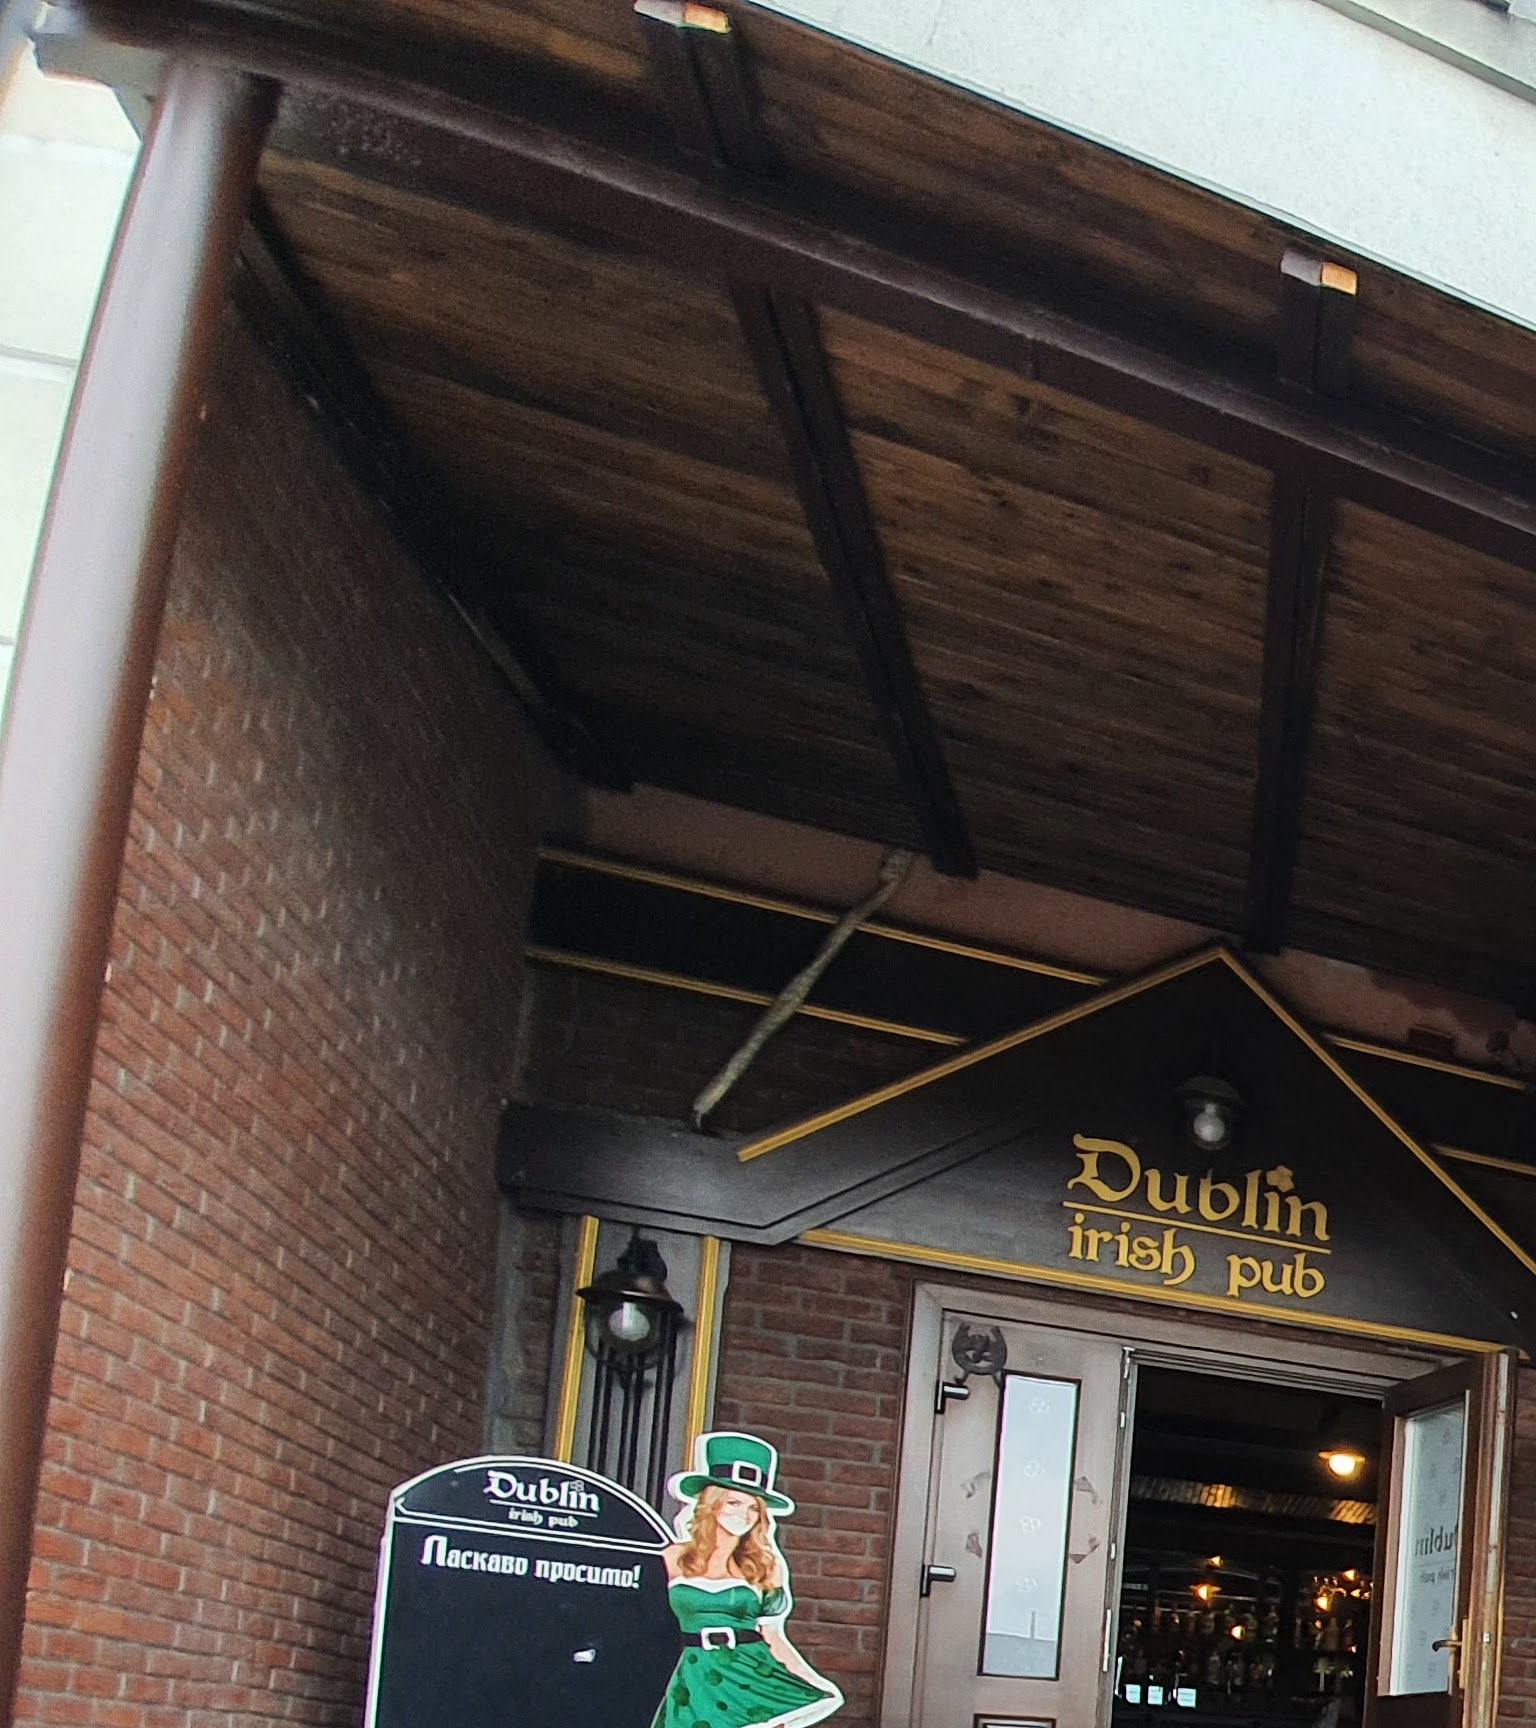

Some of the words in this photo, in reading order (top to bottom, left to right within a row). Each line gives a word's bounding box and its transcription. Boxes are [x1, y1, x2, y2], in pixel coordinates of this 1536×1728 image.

[1067, 1133, 1331, 1242] Dublin
[1068, 1212, 1196, 1287] irish
[1226, 1252, 1326, 1298] pub
[483, 1470, 600, 1512] Dublin
[508, 1508, 544, 1525] irish
[548, 1515, 579, 1528] pub
[420, 1534, 528, 1575] Ласкаво
[534, 1559, 642, 1589] просимо!
